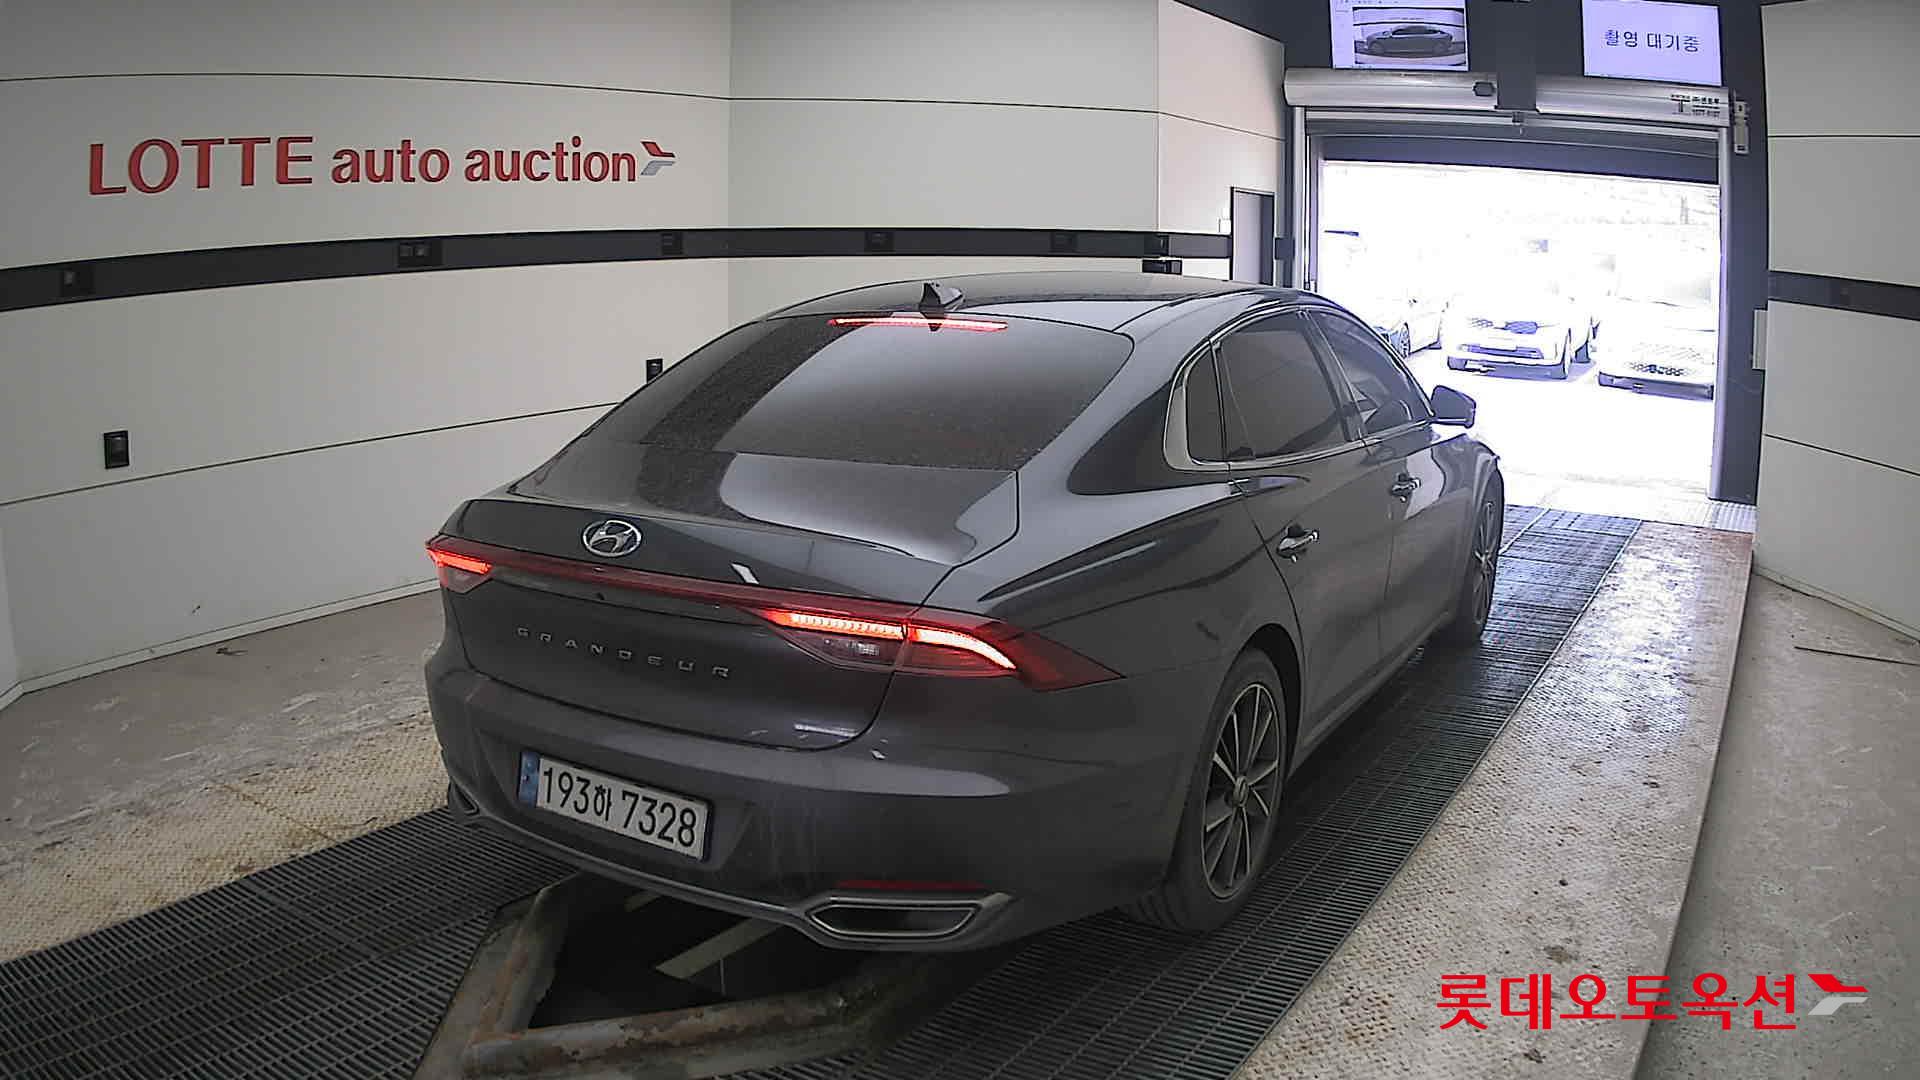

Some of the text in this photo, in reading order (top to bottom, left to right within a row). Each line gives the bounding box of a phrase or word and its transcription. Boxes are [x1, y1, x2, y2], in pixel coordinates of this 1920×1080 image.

[1605, 29, 1700, 53] 촬영 대기중
[88, 135, 638, 196] LOTTE auto auction
[516, 626, 730, 679] GRANDEUR
[542, 766, 698, 849] 193하 7328
